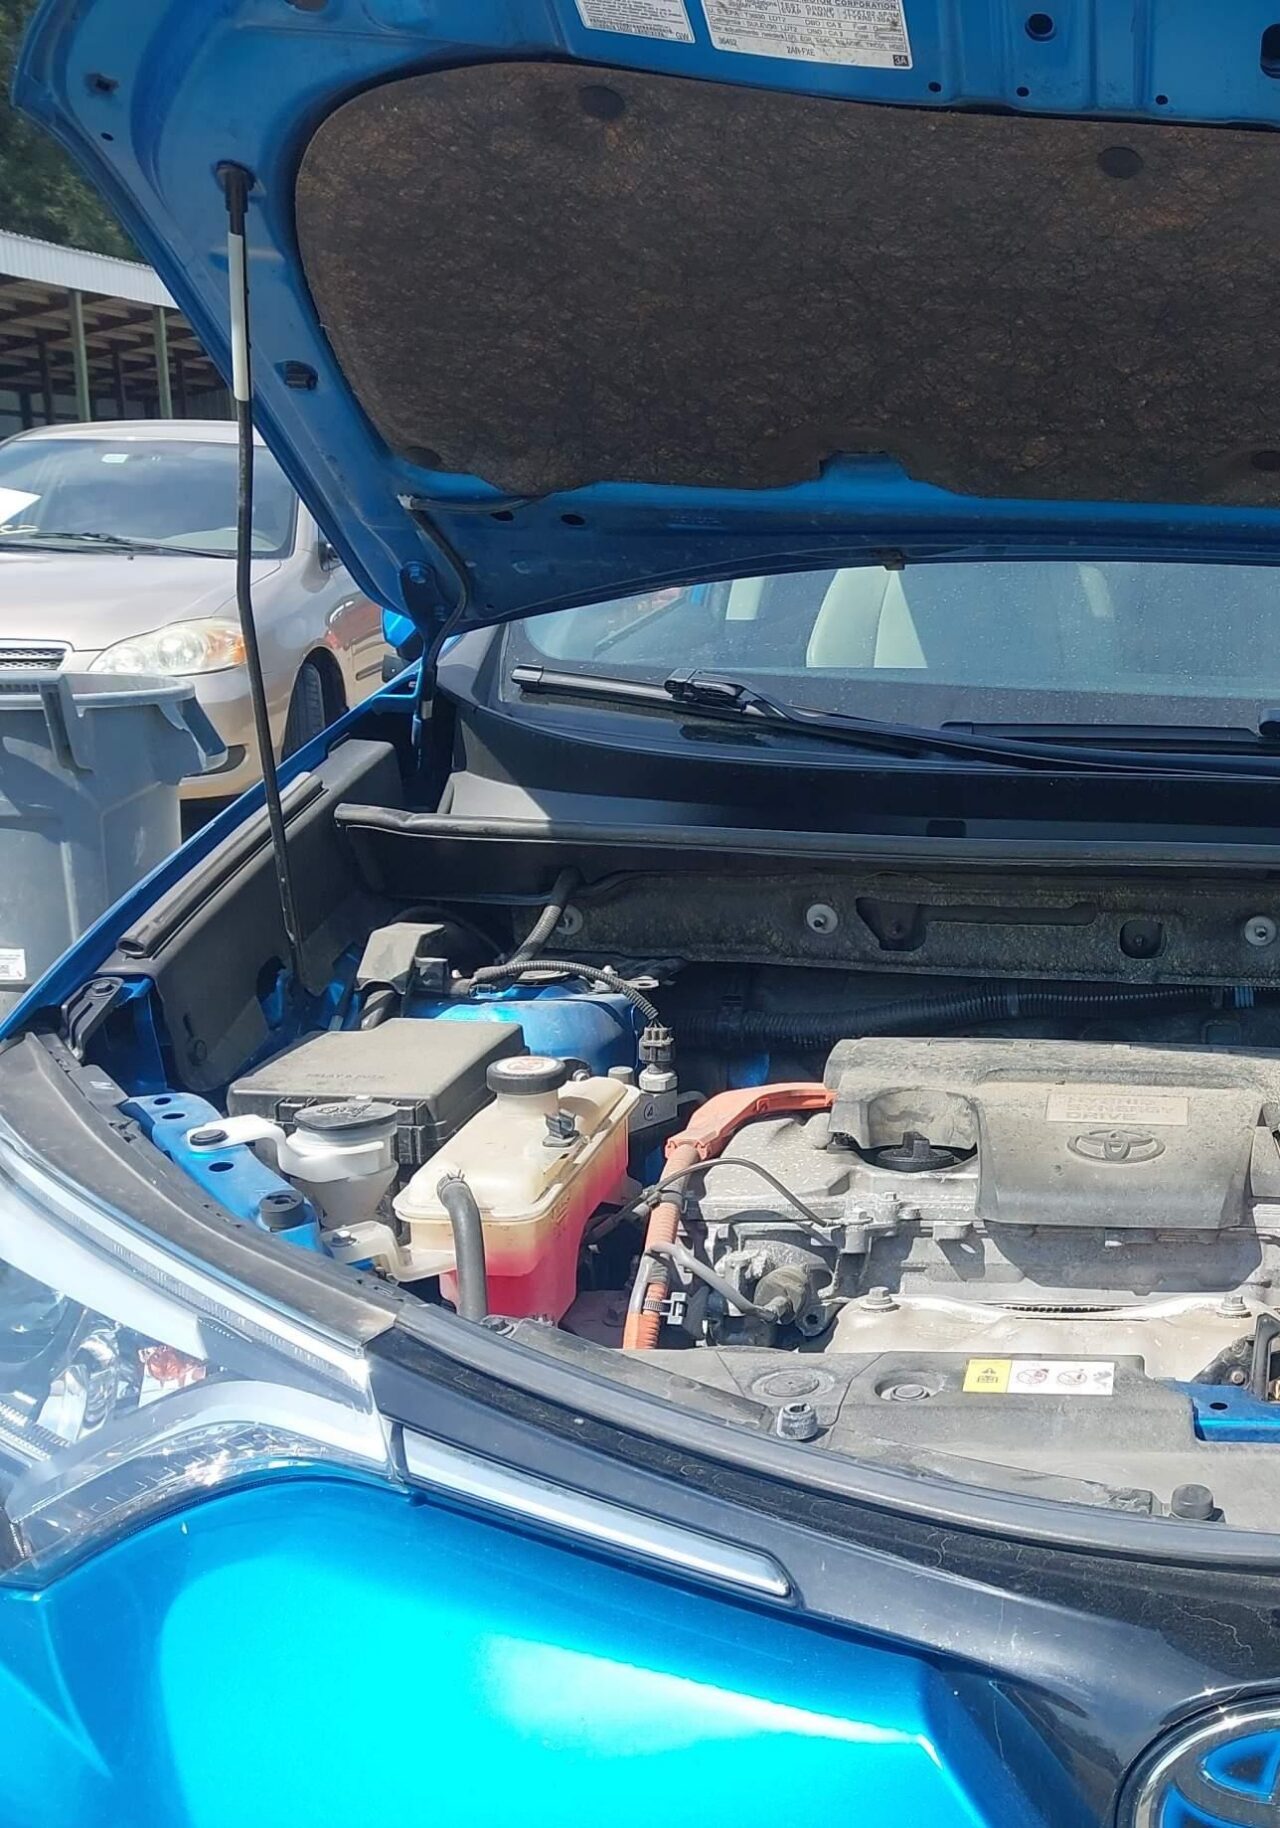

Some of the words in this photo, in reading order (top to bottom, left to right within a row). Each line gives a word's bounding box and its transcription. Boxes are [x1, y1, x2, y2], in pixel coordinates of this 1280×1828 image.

[835, 0, 896, 9] CORPORATION
[894, 56, 907, 65] 3A
[1066, 1111, 1137, 1121] DRIVE
